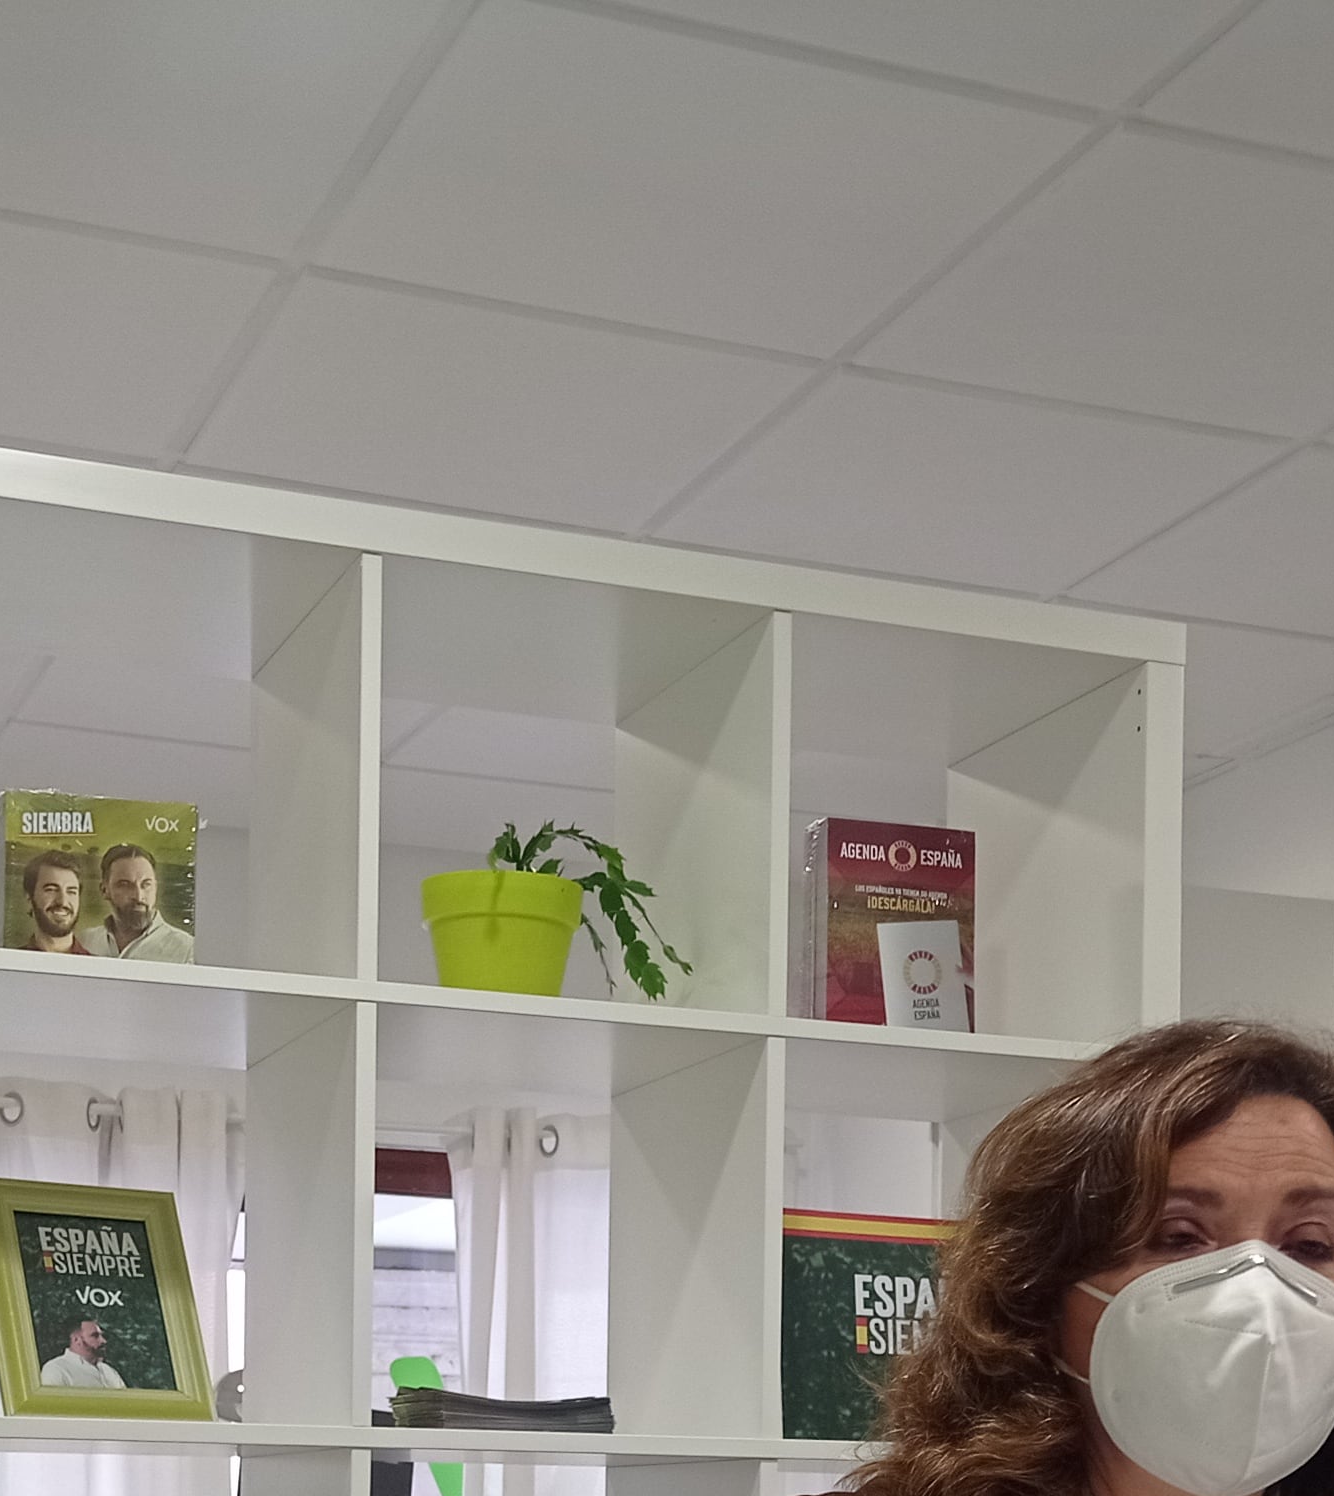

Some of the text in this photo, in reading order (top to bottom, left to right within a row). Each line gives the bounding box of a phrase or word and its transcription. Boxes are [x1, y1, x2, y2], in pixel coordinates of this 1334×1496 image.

[21, 811, 180, 834] SIEMBRA VOX
[840, 841, 963, 869] AGENDA ESPAÑA
[912, 998, 940, 1010] AGENDA
[913, 1009, 941, 1021] ESPAÑA
[38, 1226, 141, 1256] ESPAÑA
[53, 1252, 145, 1278] SIEMPRE
[75, 1285, 125, 1308] VOX
[853, 1273, 941, 1319] ESPA
